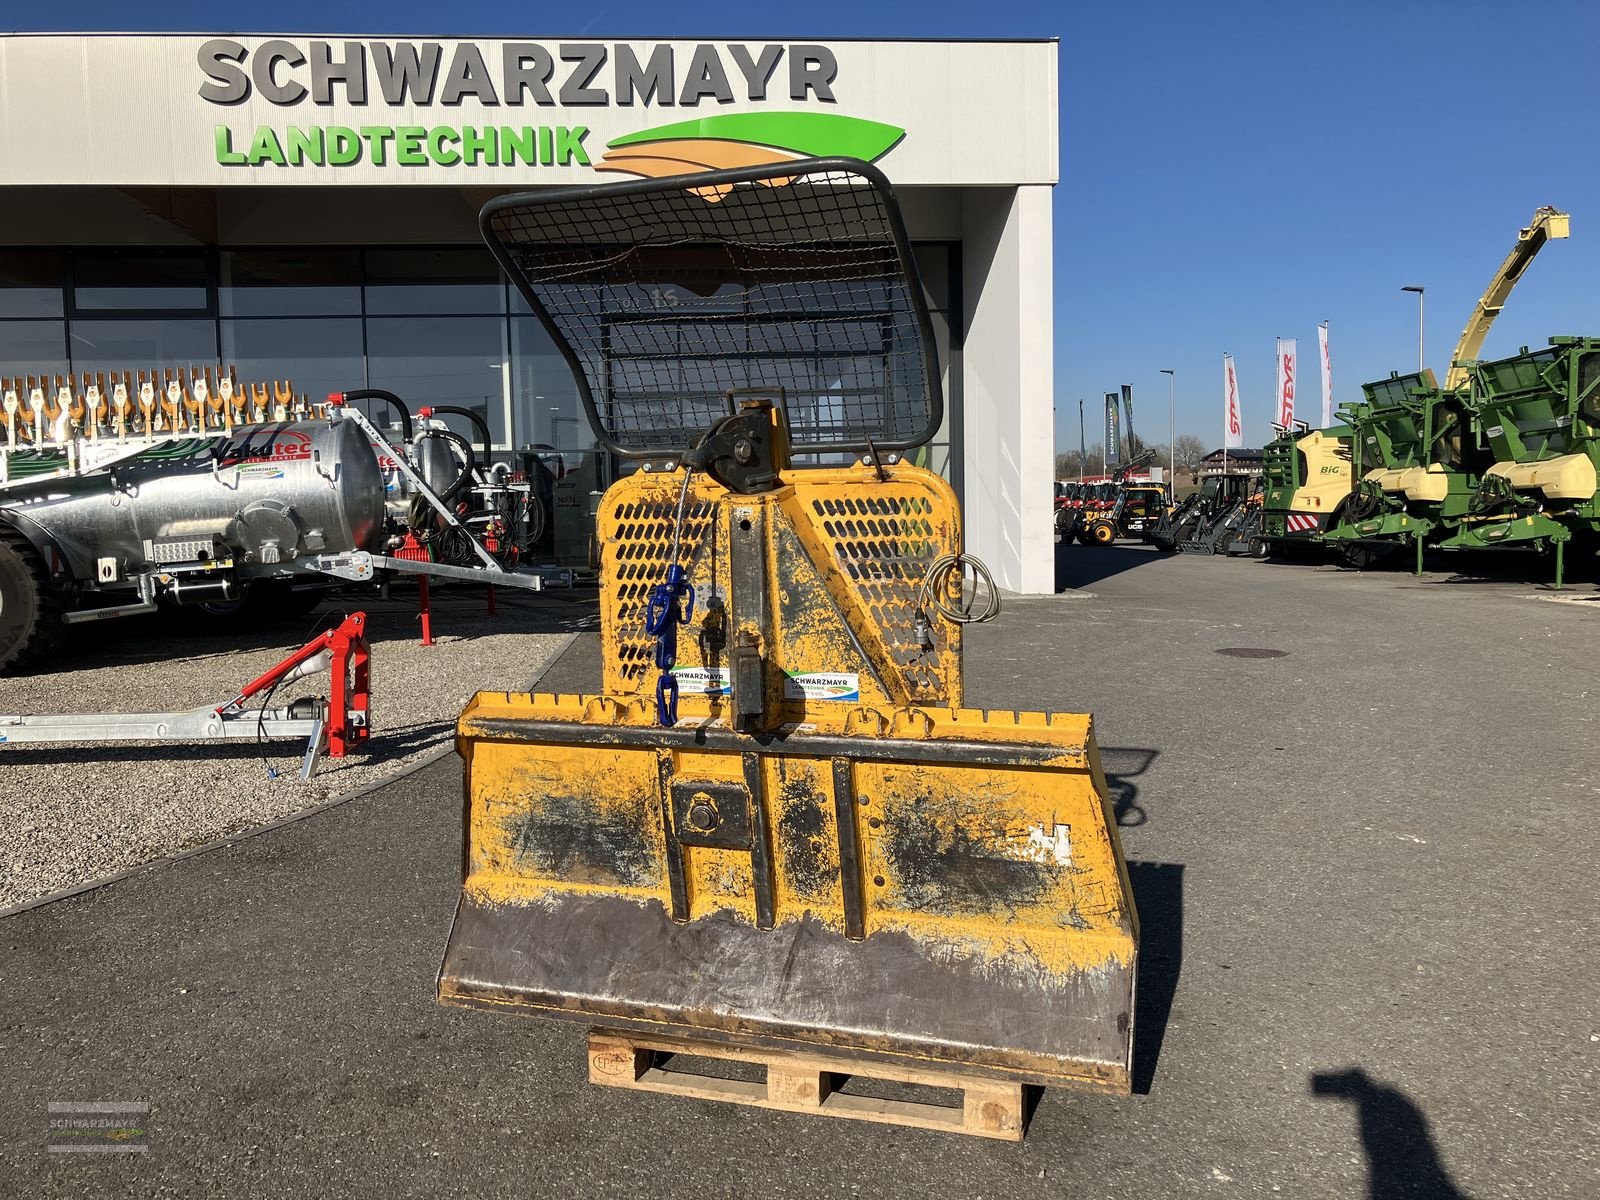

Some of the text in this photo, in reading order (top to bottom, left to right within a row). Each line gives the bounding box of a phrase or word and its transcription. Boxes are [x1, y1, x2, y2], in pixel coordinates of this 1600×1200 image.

[198, 39, 838, 106] SCHWARZMAYR
[215, 124, 591, 168] LANDTECHNIK
[652, 288, 679, 307] 16
[1281, 353, 1294, 428] STEYR
[210, 441, 311, 465] Vakutec
[1319, 465, 1340, 474] BiG
[791, 677, 848, 686] SCHWARZMAYR
